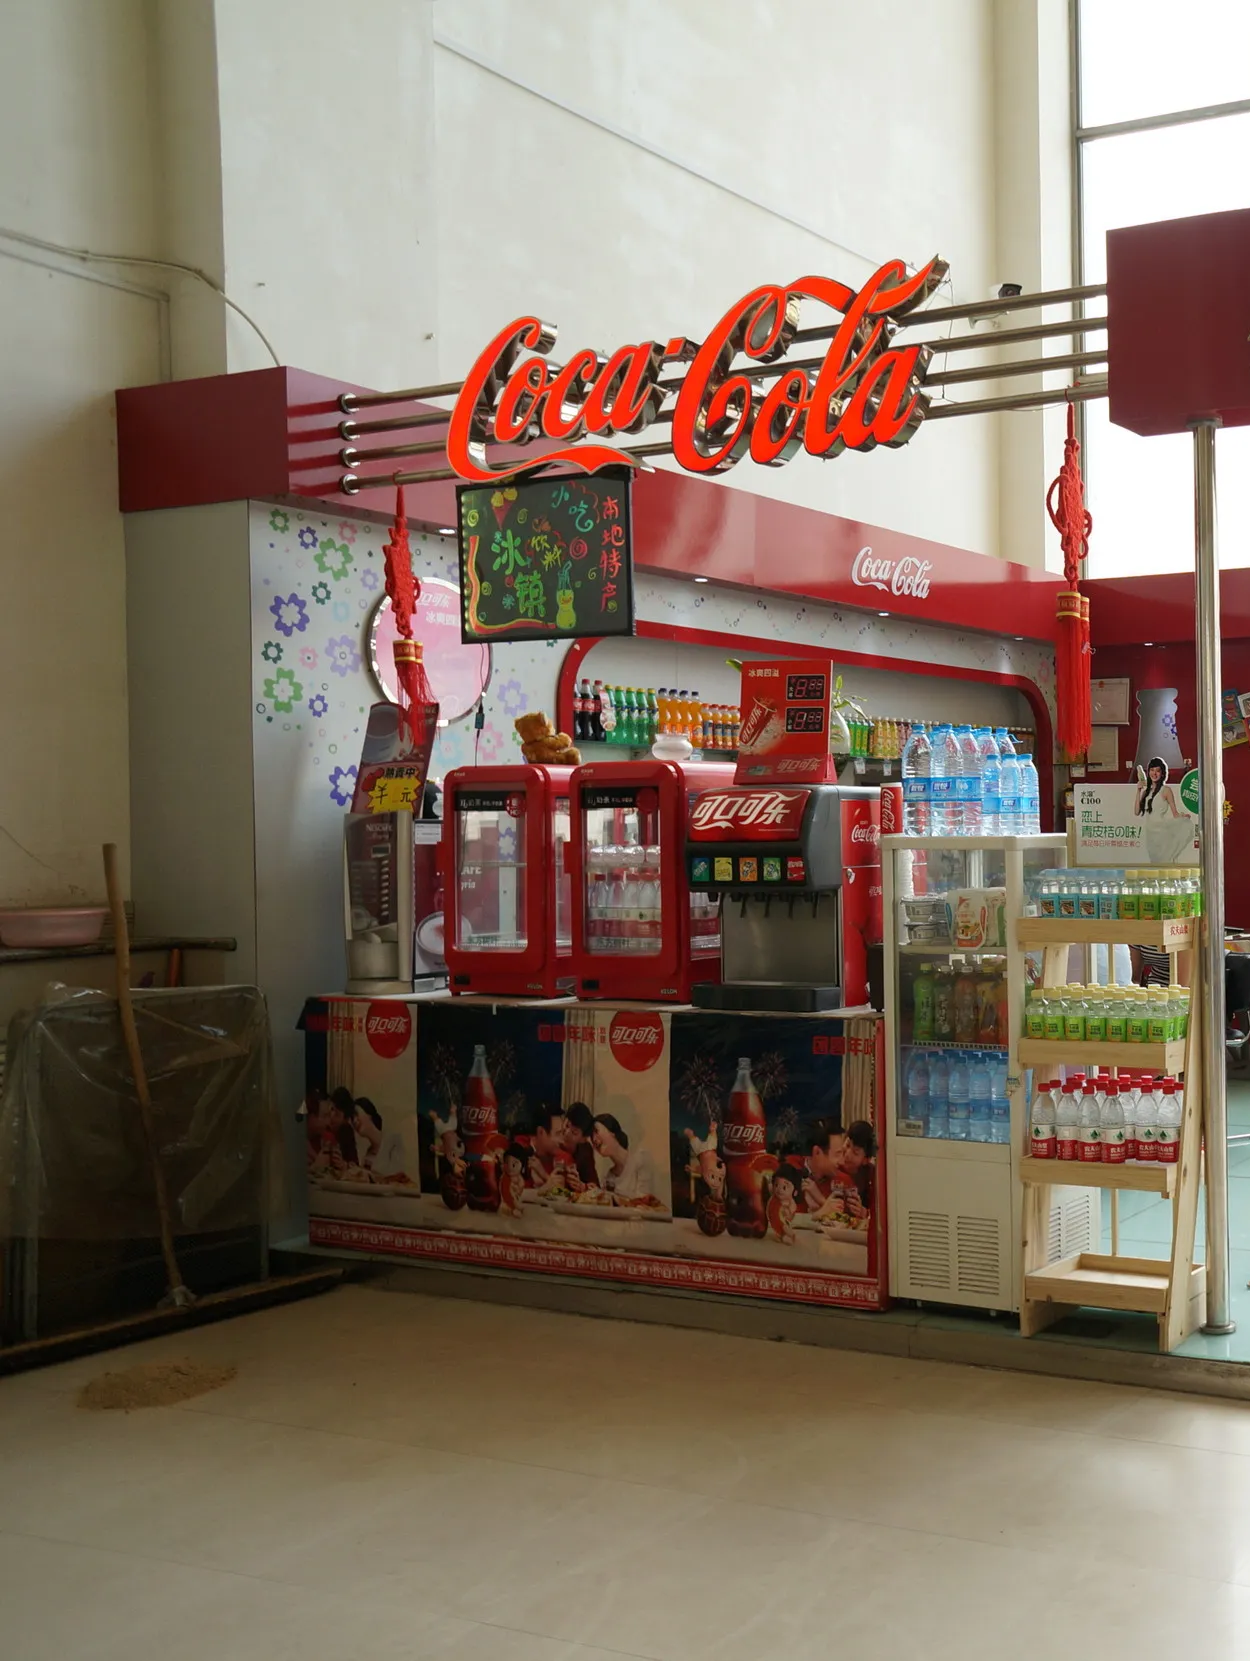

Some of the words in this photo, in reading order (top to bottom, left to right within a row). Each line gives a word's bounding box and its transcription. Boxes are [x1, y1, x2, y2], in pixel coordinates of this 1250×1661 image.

[851, 545, 934, 600] Coca-Cola
[425, 612, 461, 627] 冰爽四
[692, 791, 801, 830] 可口可乐
[1081, 810, 1104, 823] 恋上
[367, 1016, 409, 1034] 可口可乐
[611, 1025, 661, 1046] 可口可乐
